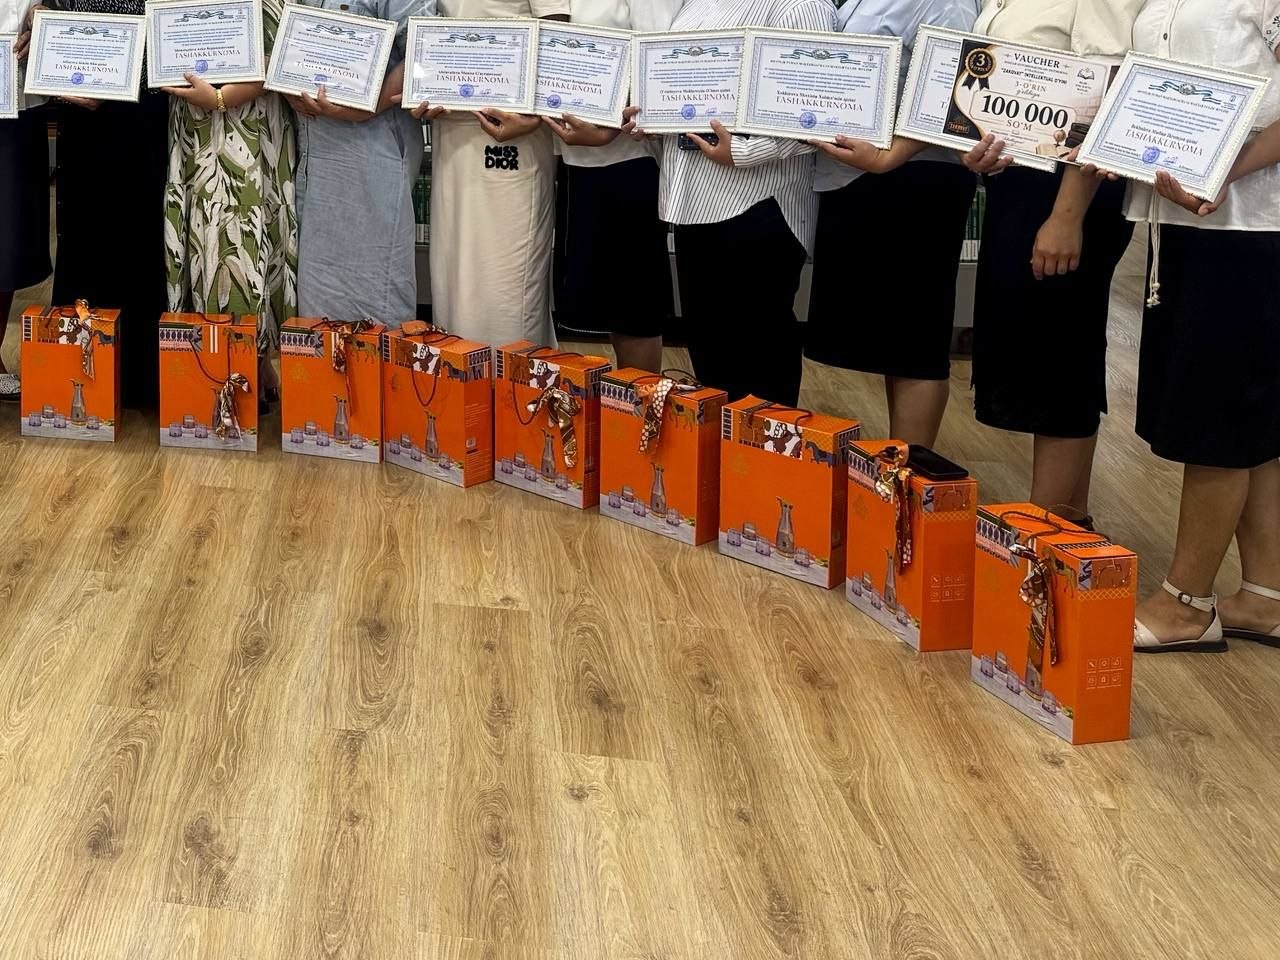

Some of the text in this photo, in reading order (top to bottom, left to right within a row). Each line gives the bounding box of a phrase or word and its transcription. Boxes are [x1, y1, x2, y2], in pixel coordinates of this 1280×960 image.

[976, 53, 986, 67] 3
[1014, 53, 1060, 68] VAUCHER
[435, 74, 510, 85] TASHAKKURNOMA
[535, 78, 603, 95] ASHAKKURNOMA
[661, 93, 736, 102] TASHAKKURNOMA
[776, 96, 864, 112] TASHAKKURNOMA
[981, 94, 1068, 129] 100 000
[1006, 118, 1033, 132] SO'M
[1125, 129, 1203, 156] TASHAKKURNOMA
[484, 145, 519, 159] MISS
[484, 156, 519, 171] DIOR
